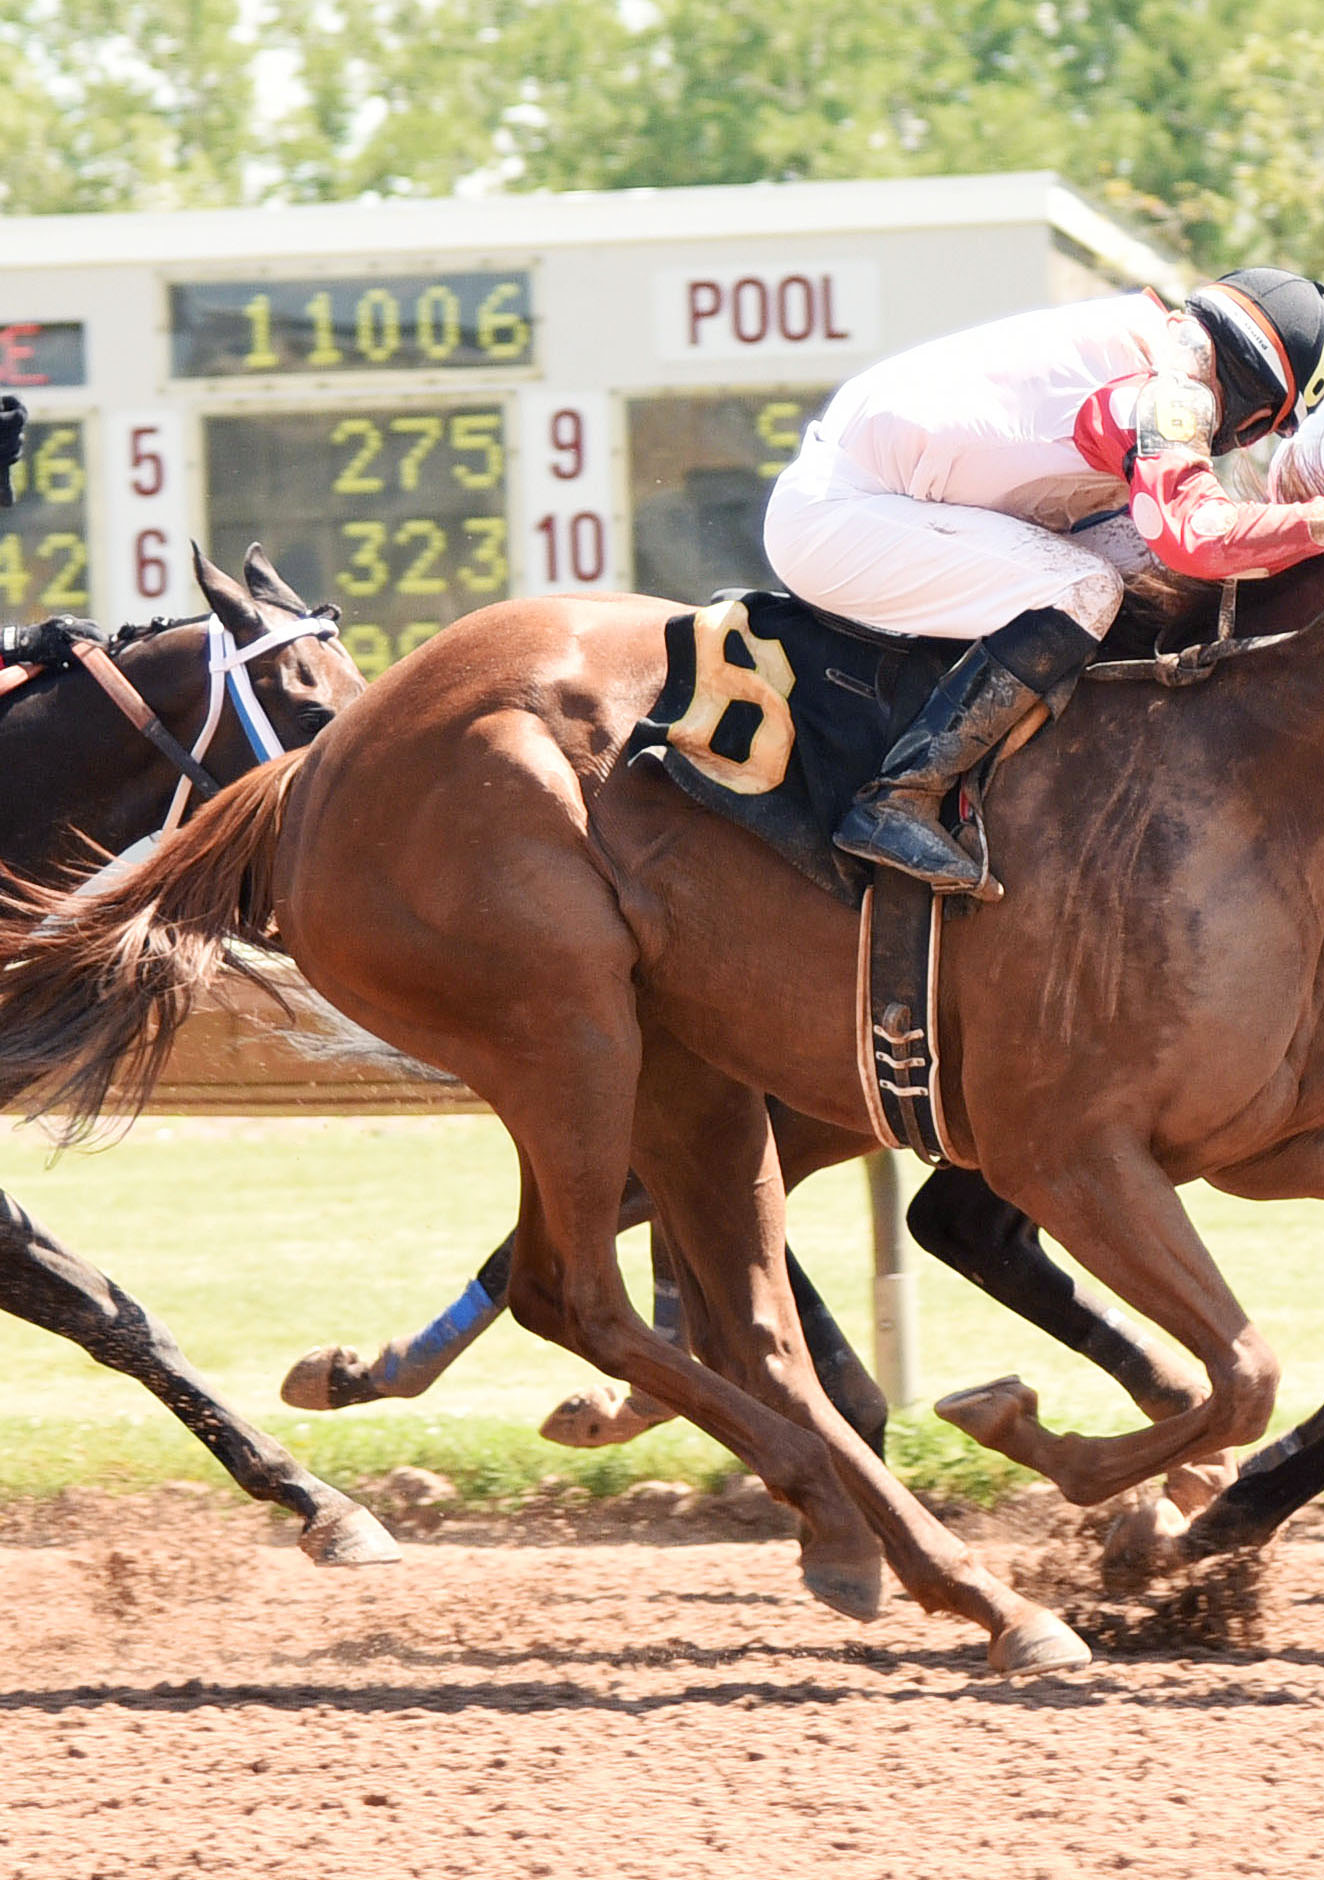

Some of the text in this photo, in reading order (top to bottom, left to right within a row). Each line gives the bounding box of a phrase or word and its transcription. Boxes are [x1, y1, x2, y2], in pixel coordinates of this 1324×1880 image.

[243, 283, 532, 367] 11006
[688, 274, 849, 345] POOL
[130, 426, 164, 497] 5
[329, 414, 504, 494] 275
[551, 408, 583, 480] 9
[135, 527, 168, 598] 6
[334, 516, 509, 597] 323
[535, 510, 605, 583] 10
